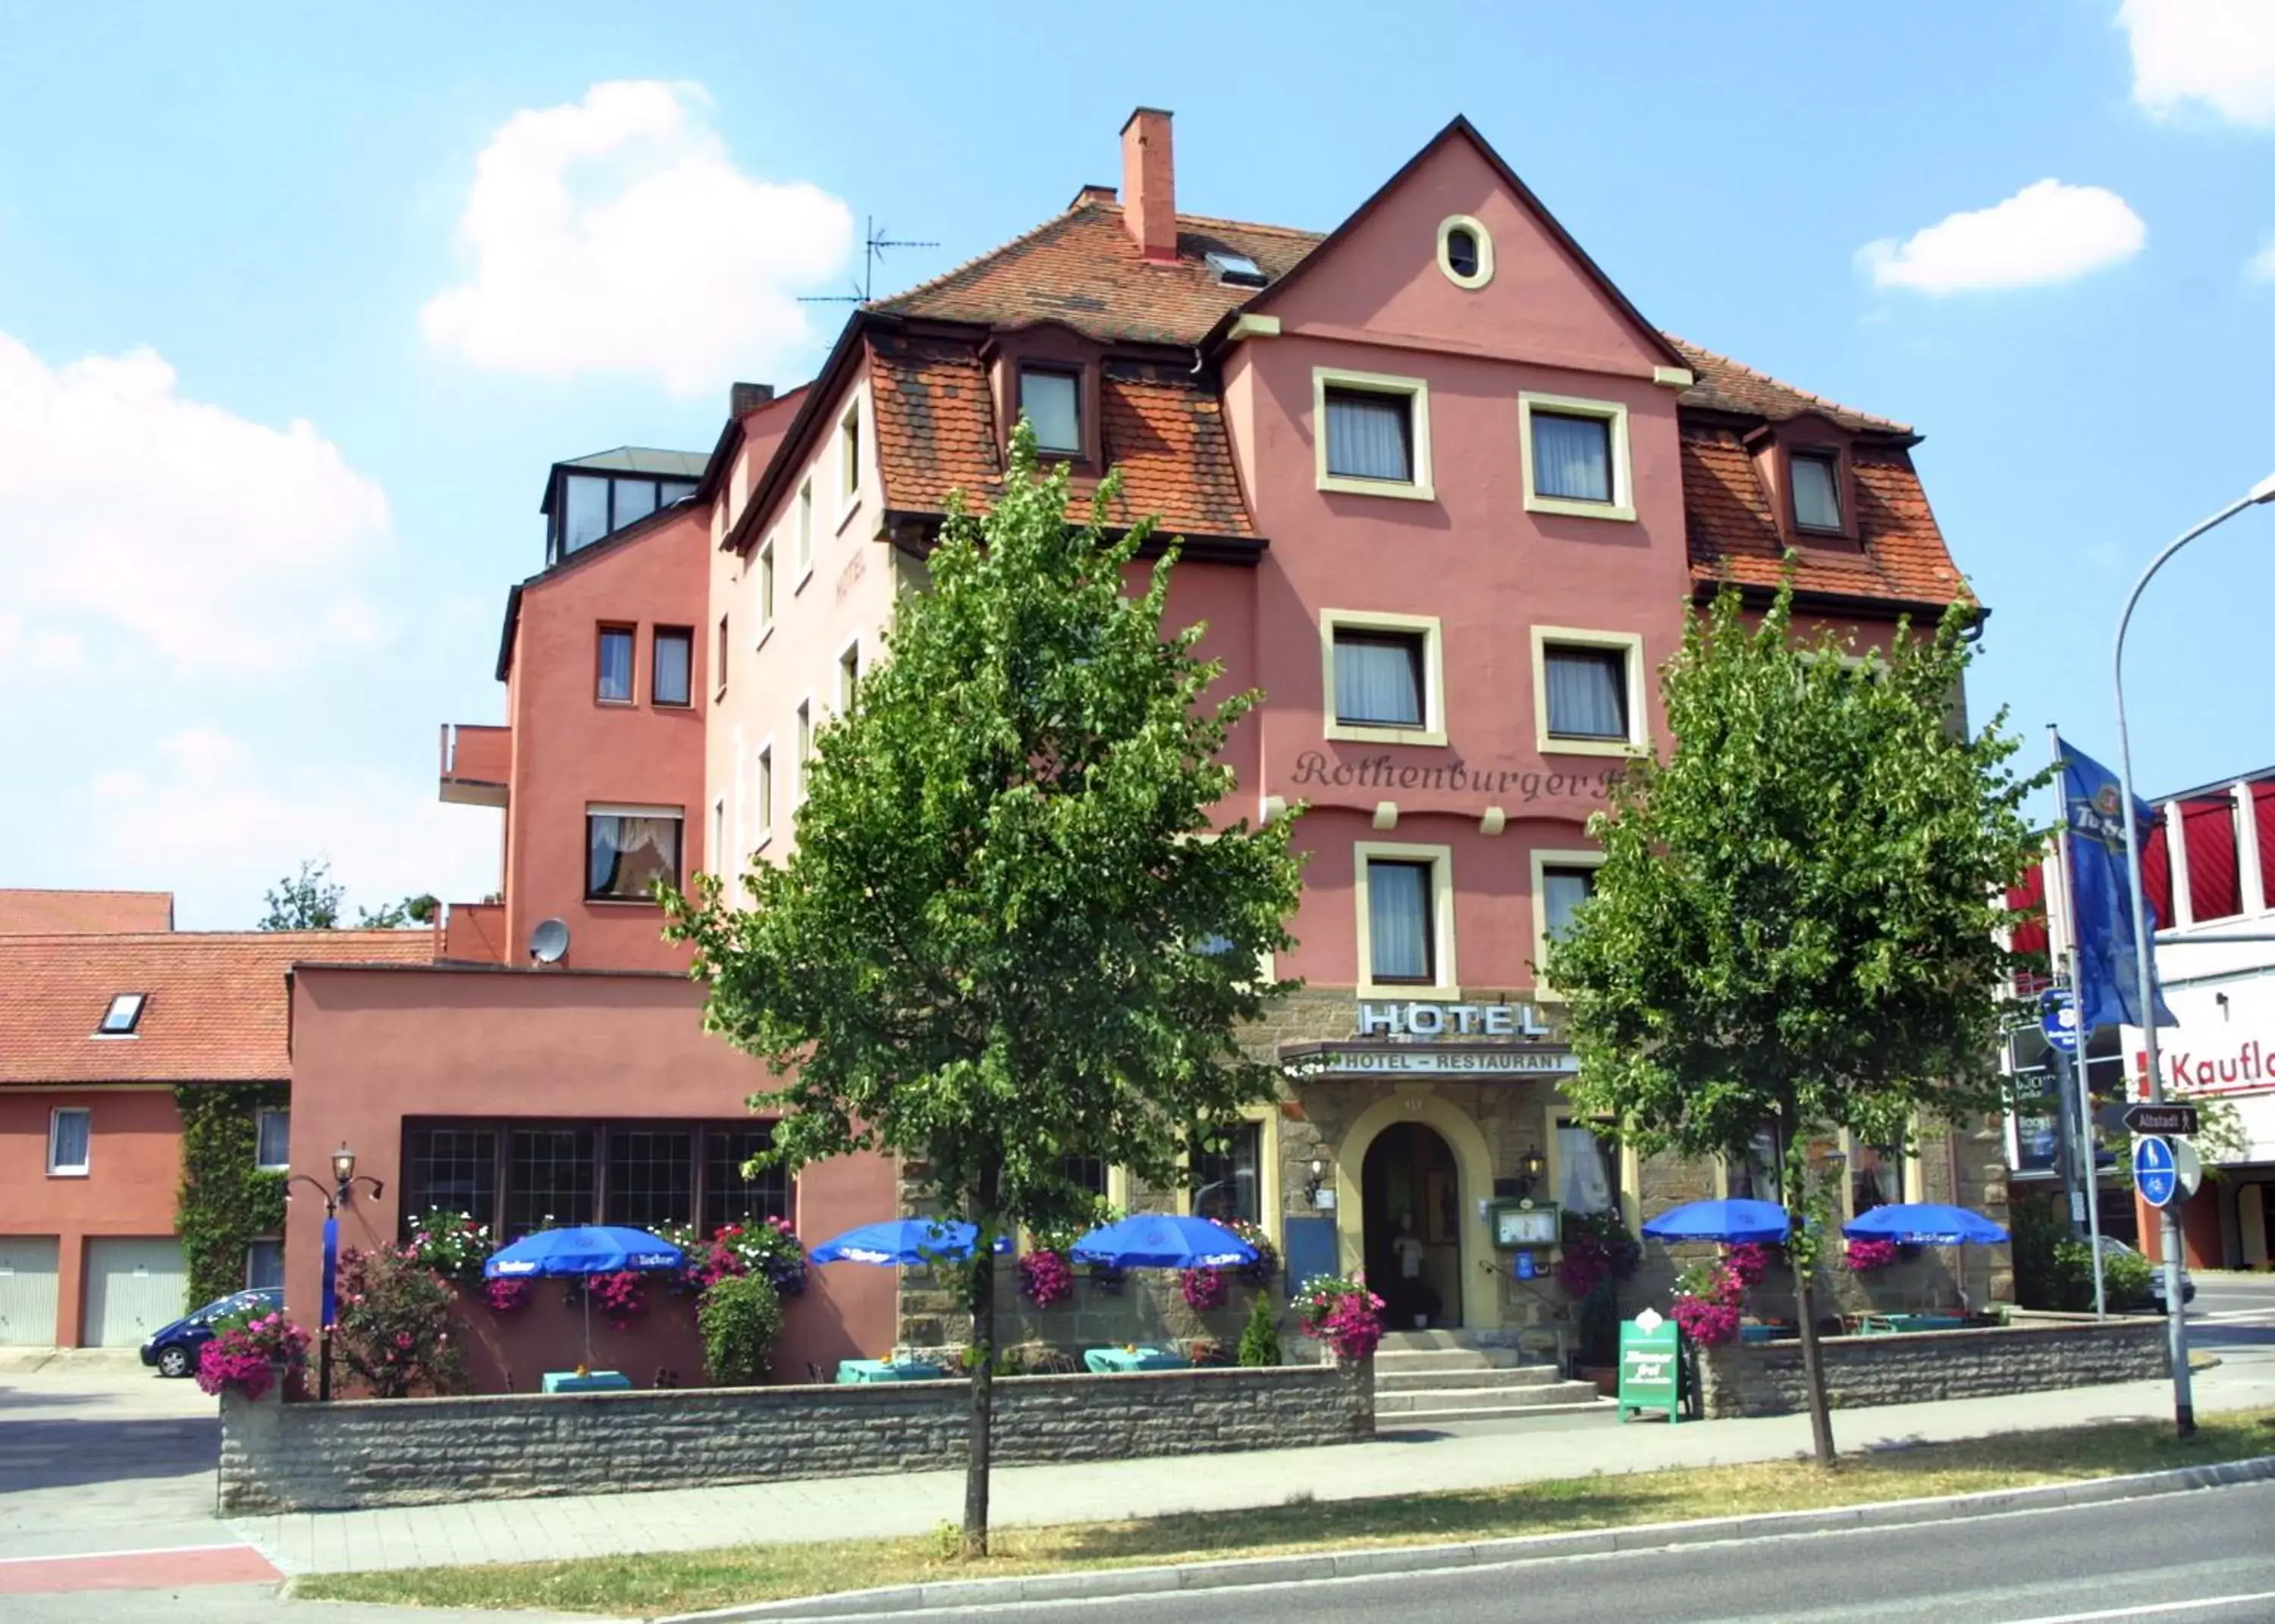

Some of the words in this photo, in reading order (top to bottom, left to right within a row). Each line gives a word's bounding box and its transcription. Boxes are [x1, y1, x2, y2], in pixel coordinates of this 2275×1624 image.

[1291, 751, 1587, 803] Rothenburger
[2076, 806, 2128, 841] Tuhe
[1361, 1004, 1549, 1035] HOTEL
[1345, 1054, 1412, 1070] HOTEL
[1436, 1054, 1564, 1070] RESTAURANT
[2138, 1113, 2179, 1128] Altstadt
